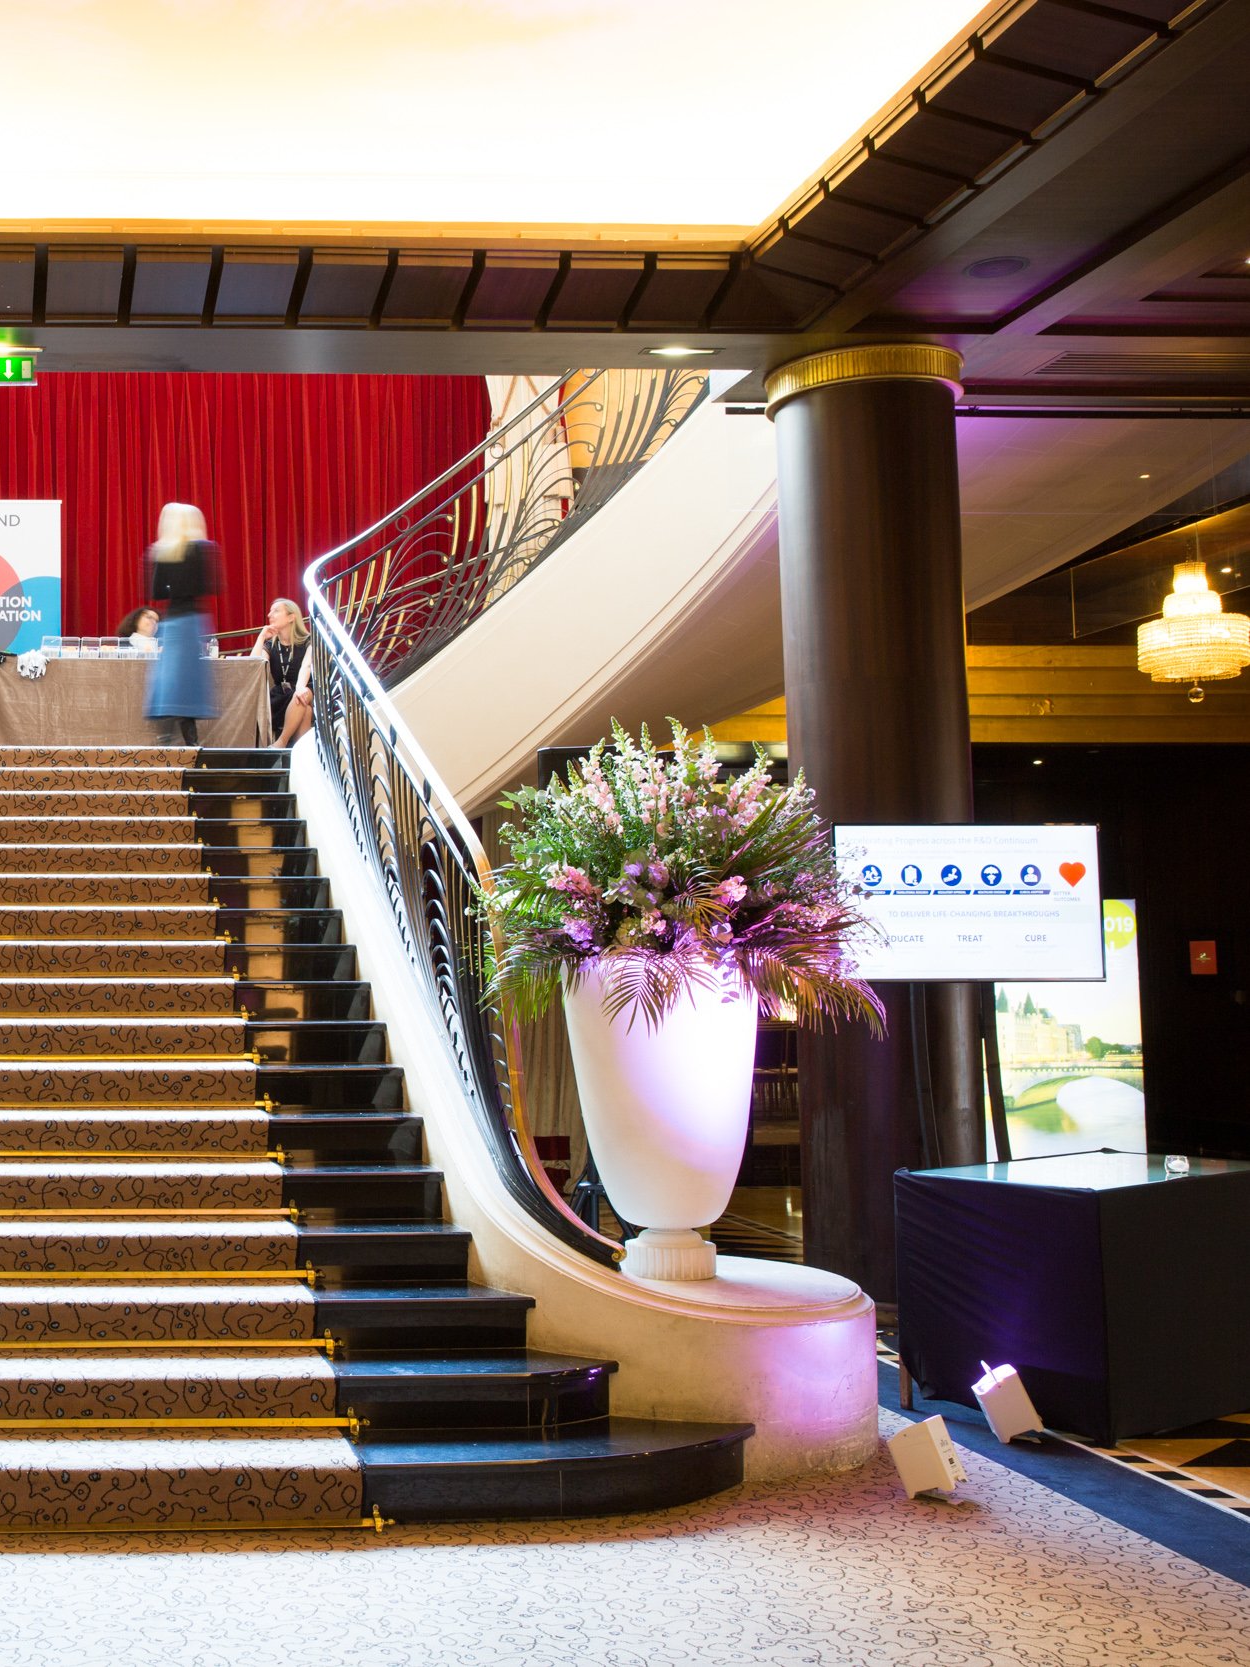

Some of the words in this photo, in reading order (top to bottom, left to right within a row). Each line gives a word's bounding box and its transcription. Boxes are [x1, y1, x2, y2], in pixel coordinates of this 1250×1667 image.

[895, 836, 929, 847] Progress
[958, 836, 971, 845] the
[973, 836, 992, 845] R&D
[993, 836, 1039, 845] Continuum
[888, 910, 899, 918] TO
[900, 910, 931, 918] DELIVER
[993, 910, 1060, 918] BREAKTHROUGHS
[1104, 916, 1134, 932] 019
[957, 934, 983, 942] TREAT
[1024, 934, 1047, 942] CURE
